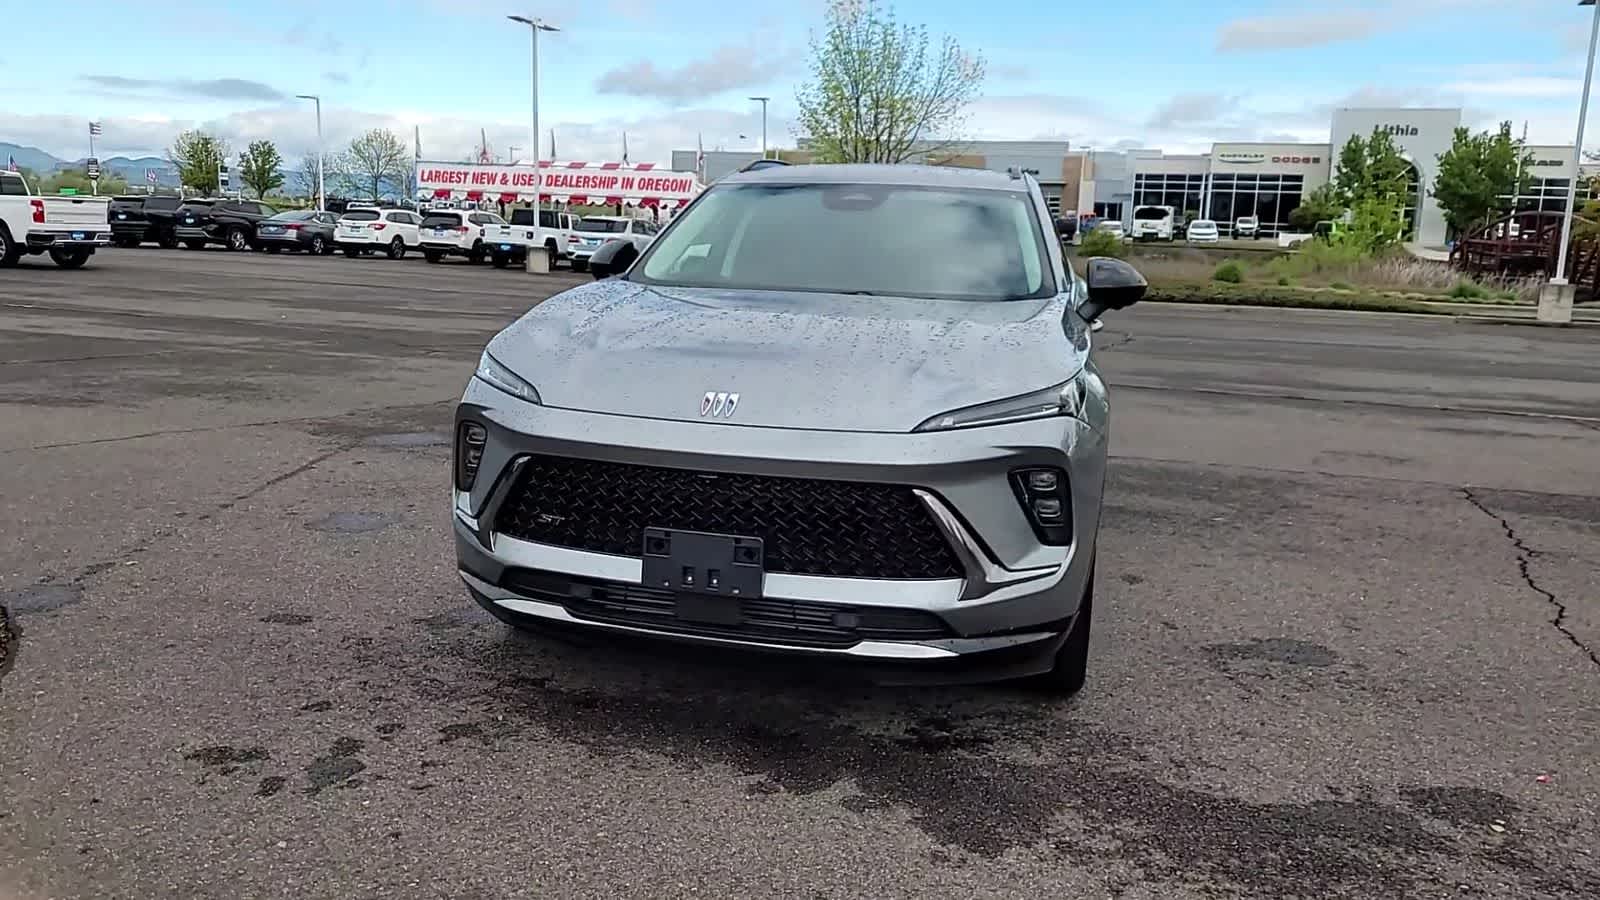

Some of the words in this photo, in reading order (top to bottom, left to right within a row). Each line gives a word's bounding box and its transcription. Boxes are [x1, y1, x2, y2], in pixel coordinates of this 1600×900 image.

[420, 169, 469, 184] LARGEST
[471, 172, 497, 186] NEW
[500, 173, 509, 186] &
[545, 174, 618, 190] DEALERSHIP
[620, 177, 634, 190] IN
